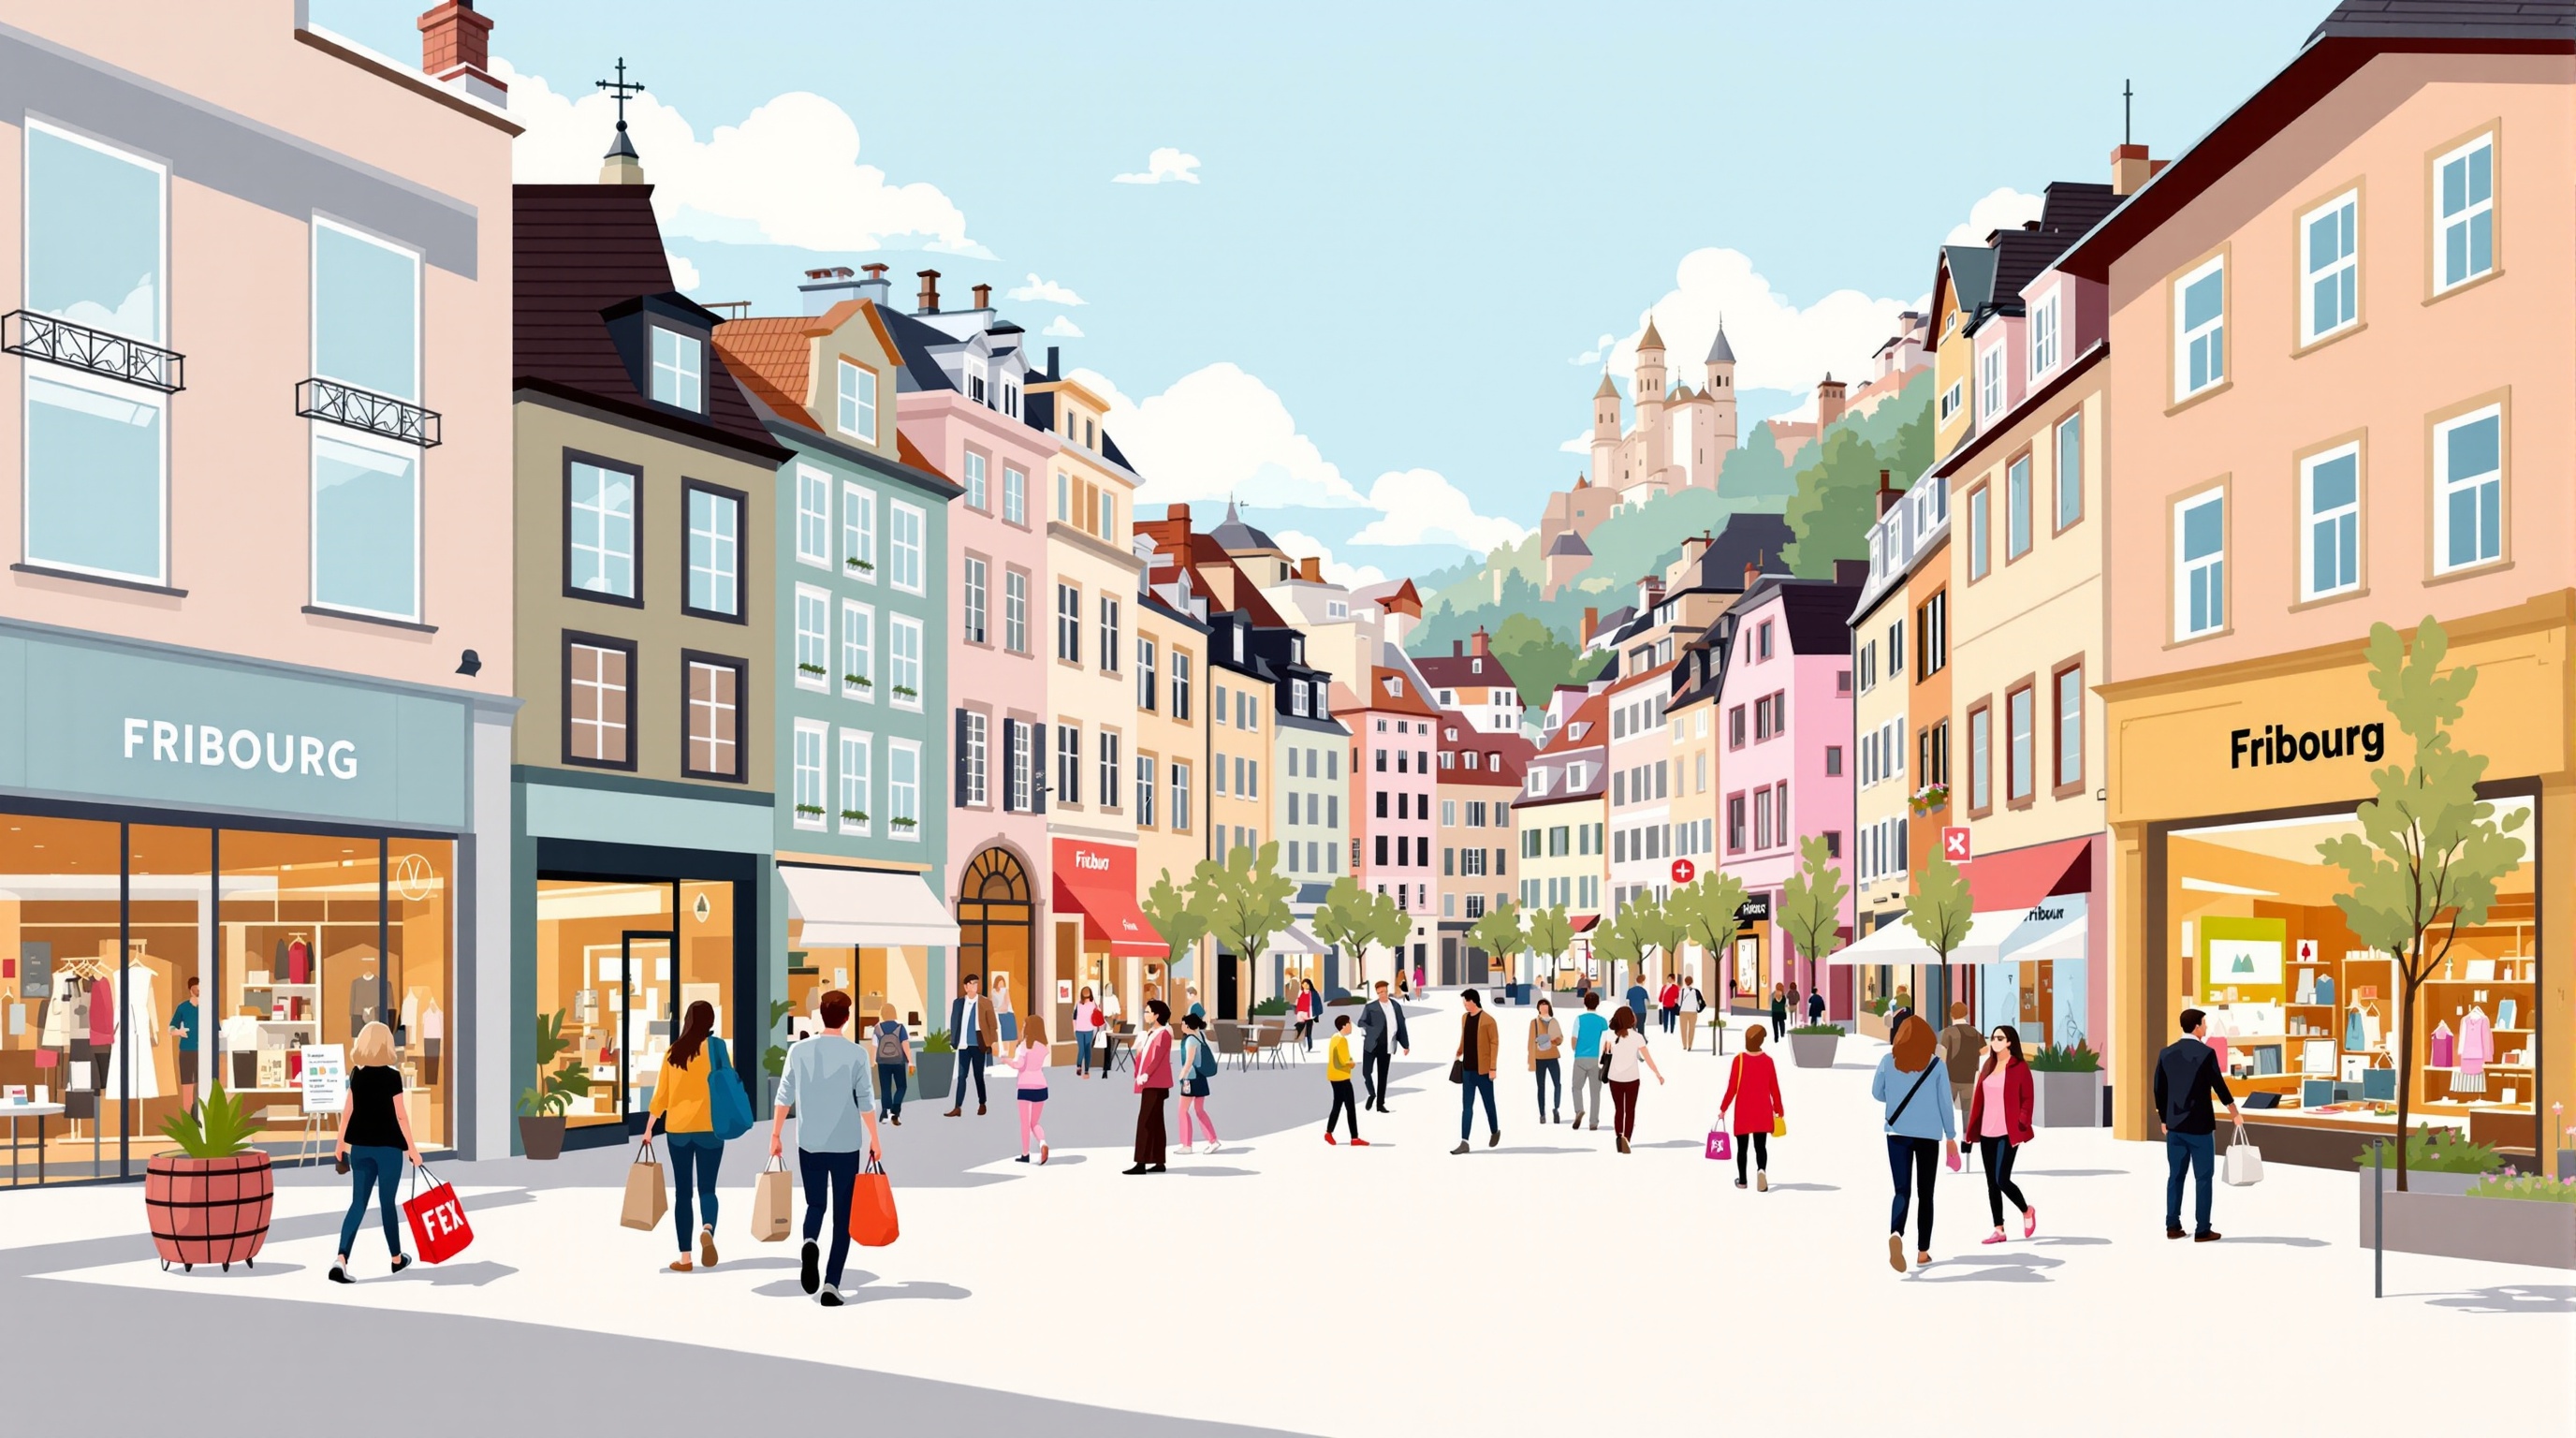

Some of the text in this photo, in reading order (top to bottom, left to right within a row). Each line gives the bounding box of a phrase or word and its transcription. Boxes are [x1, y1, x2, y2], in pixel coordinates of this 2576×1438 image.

[124, 717, 358, 780] FRIBOURG
[2231, 722, 2384, 770] Fribourg
[420, 1199, 464, 1242] FEX
